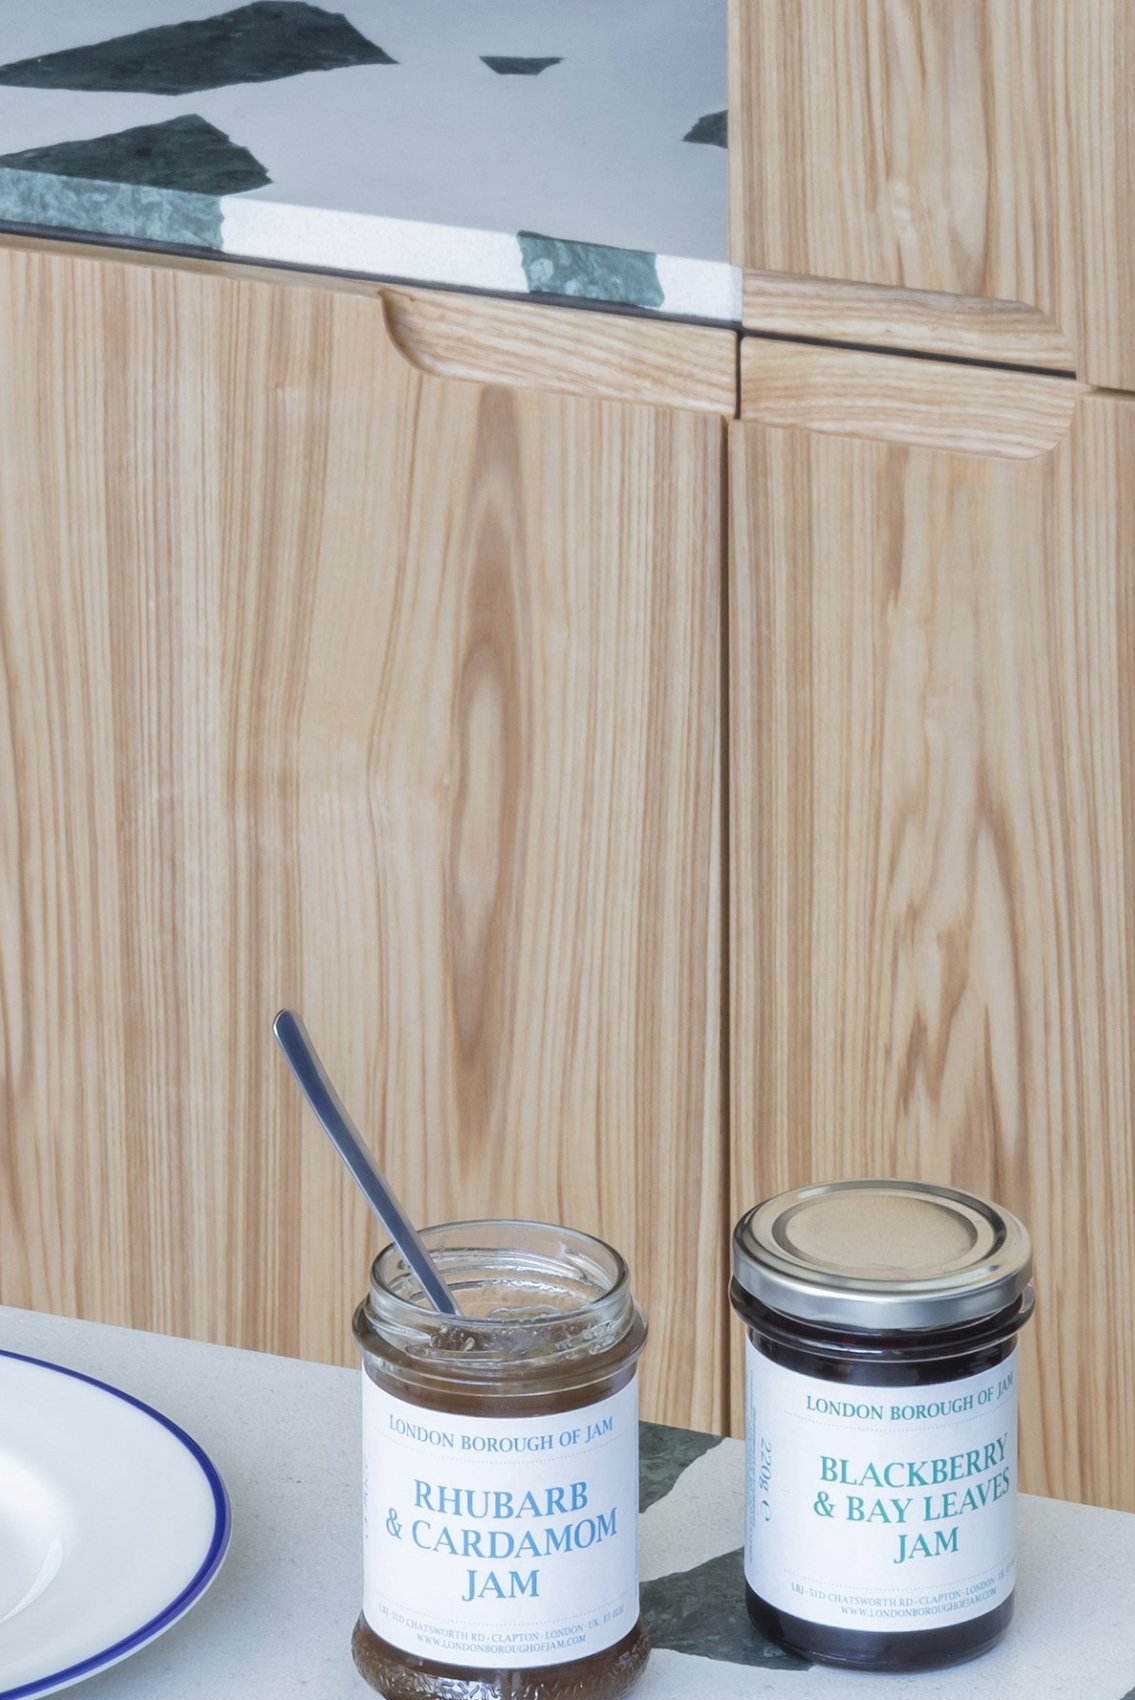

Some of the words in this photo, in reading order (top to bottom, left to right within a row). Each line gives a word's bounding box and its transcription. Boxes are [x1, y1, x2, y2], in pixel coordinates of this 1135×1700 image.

[806, 1395, 883, 1420] LONDON
[890, 1396, 973, 1421] BOROUGH
[977, 1387, 996, 1405] OF
[996, 1371, 1014, 1400] JAM
[389, 1414, 455, 1448] LONDON
[461, 1434, 554, 1452] BOROUGH
[559, 1428, 581, 1447] OF
[584, 1416, 614, 1443] JAM
[819, 1432, 1008, 1488] BLACKBERRY
[413, 1479, 588, 1519] RHUBARB
[813, 1491, 835, 1518] &
[846, 1495, 913, 1523] BAY
[923, 1466, 1010, 1521] LEAVES
[385, 1507, 403, 1540] &
[411, 1507, 618, 1559] CARDAMOM
[893, 1527, 960, 1564] JAM
[462, 1569, 540, 1602] JAM
[828, 1592, 897, 1607] CHATSWORTH
[898, 1597, 913, 1607] RD
[919, 1590, 961, 1606] CLAPTON
[965, 1578, 995, 1596] LONDON
[841, 1586, 997, 1618] WWW.LONDONBOROUGHOFJAM.COM
[406, 1618, 468, 1640] CHATSWORTH
[471, 1632, 486, 1642] RD
[491, 1630, 540, 1643] CLAPTON
[545, 1623, 584, 1640] LONDON
[416, 1632, 587, 1654] WWW.LONDONBOROUGHOFJAM.COM
